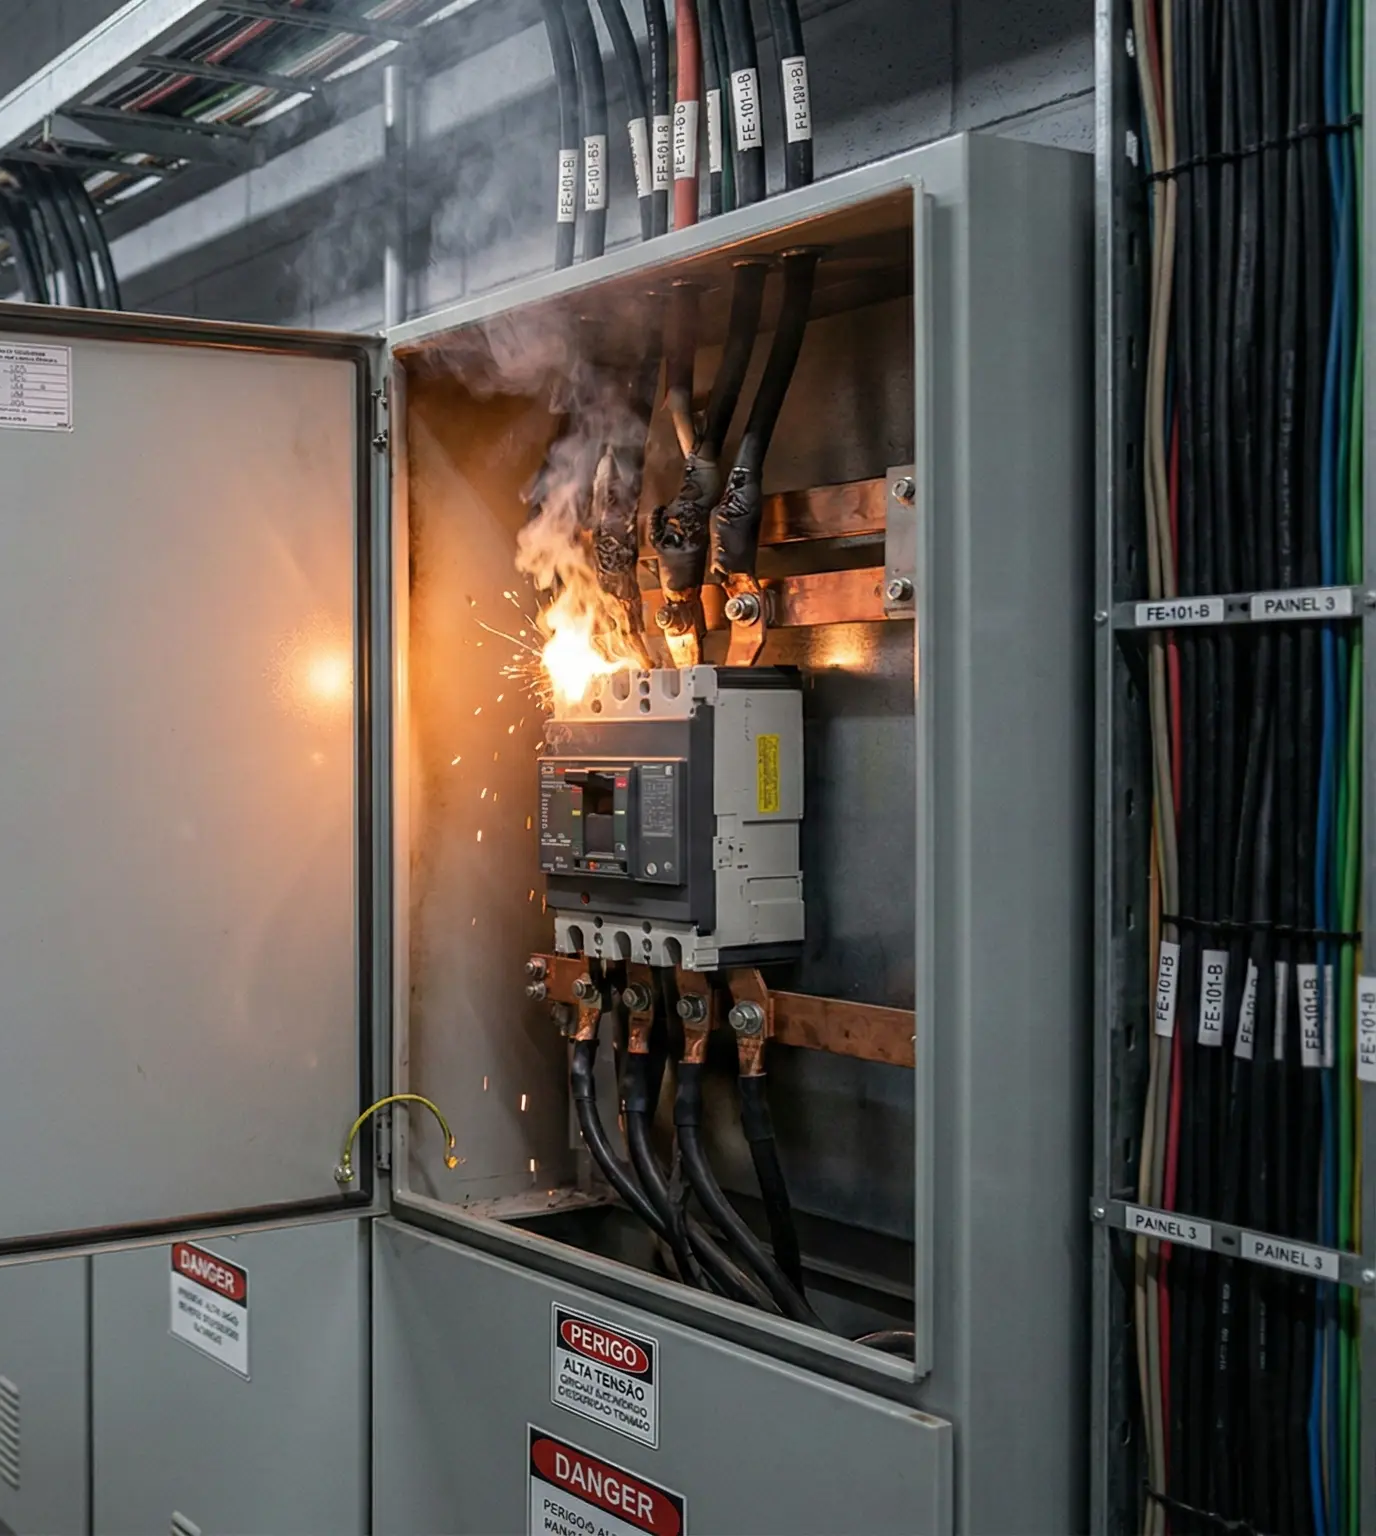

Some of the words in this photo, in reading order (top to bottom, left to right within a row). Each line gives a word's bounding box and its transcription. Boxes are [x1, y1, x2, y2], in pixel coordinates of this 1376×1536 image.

[1147, 603, 1210, 621] FE-101-B
[1265, 598, 1320, 613] PAINEL
[1325, 596, 1336, 611] 3
[1156, 955, 1174, 1021] FE-101-B
[1205, 963, 1223, 1032] FE-101-B
[1135, 1214, 1185, 1239] PAINEL
[1187, 1226, 1197, 1240] 3
[181, 1249, 235, 1293] DANGER
[1254, 1241, 1310, 1268] PAINEL
[1313, 1256, 1323, 1271] 3
[570, 1324, 637, 1367] PERIGO
[563, 1357, 592, 1381] ALTA
[594, 1369, 644, 1401] TENSÃO
[555, 1452, 654, 1524] DANGER
